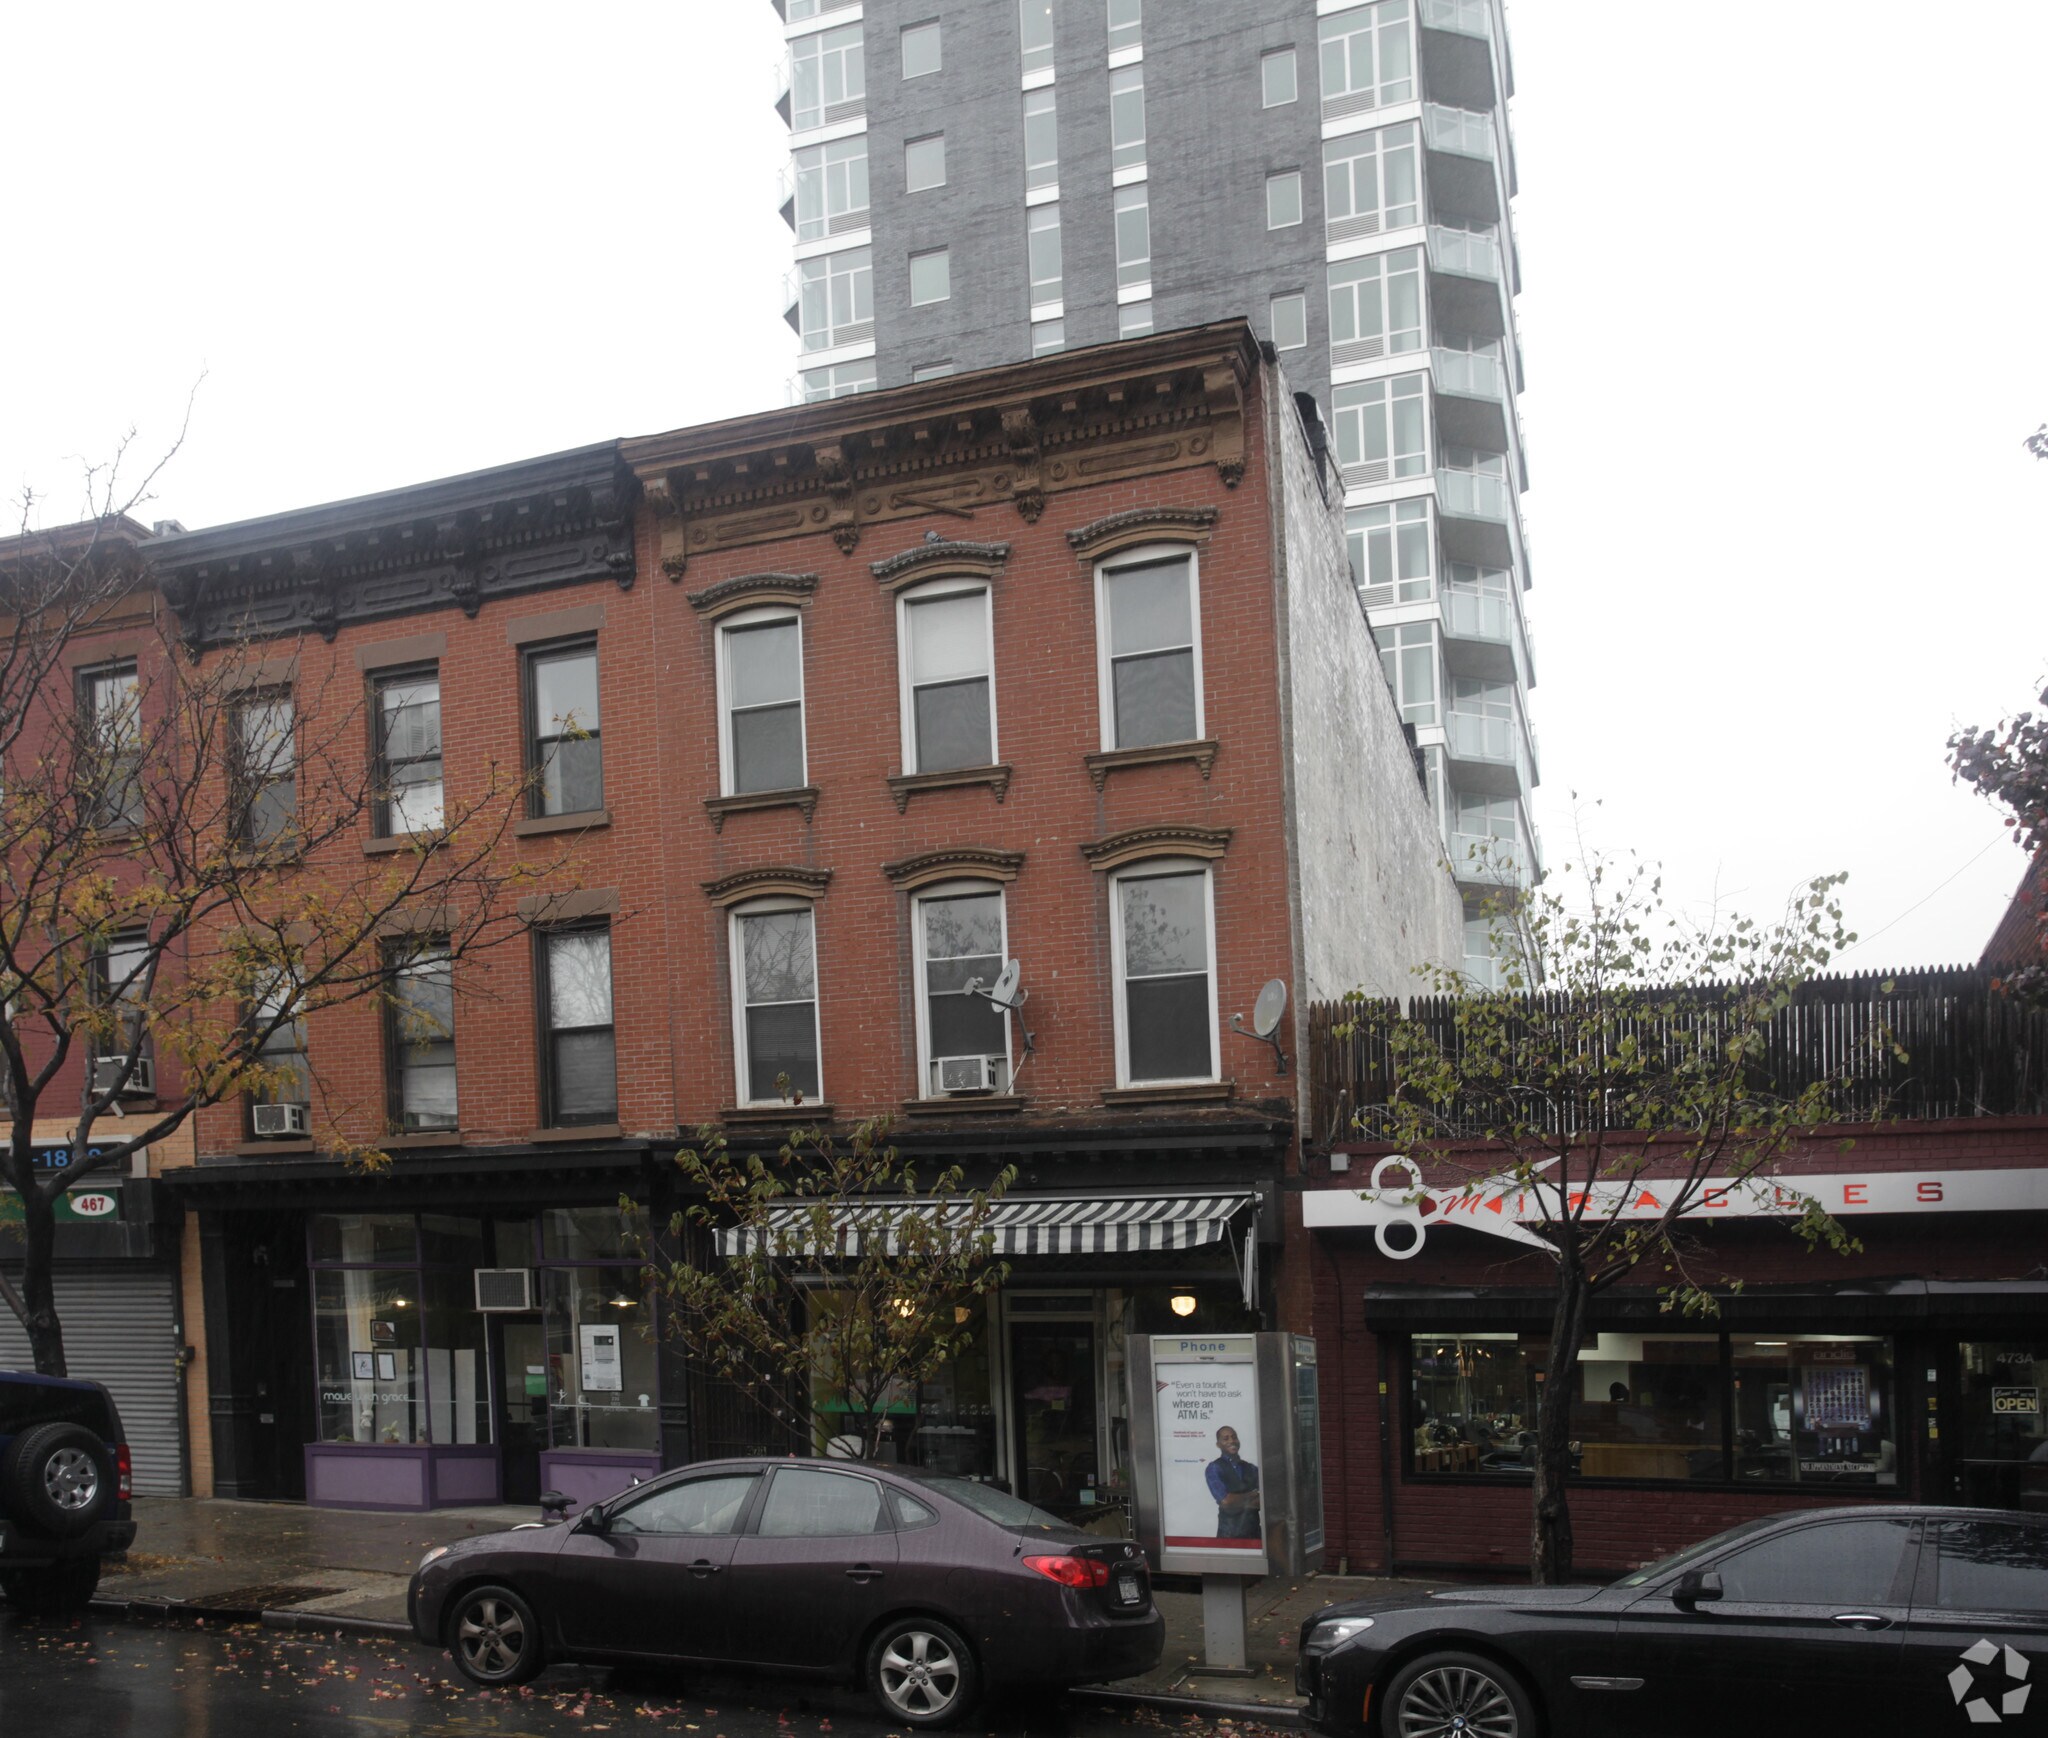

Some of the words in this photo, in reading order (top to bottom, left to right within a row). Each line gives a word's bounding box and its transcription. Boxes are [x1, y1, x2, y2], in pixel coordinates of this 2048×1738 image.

[81, 1197, 105, 1211] 467
[1180, 1341, 1226, 1352] Phone
[1997, 1353, 2034, 1364] 473A
[1202, 1381, 1227, 1389] tourist
[323, 1392, 352, 1401] move
[381, 1393, 409, 1405] grace
[1176, 1390, 1197, 1398] won't
[1198, 1390, 1217, 1398] have
[1218, 1390, 1227, 1398] to
[1227, 1390, 1242, 1398] ask
[1172, 1400, 1200, 1409] where
[1201, 1401, 1213, 1409] an
[1995, 1398, 2036, 1410] OPEN
[1177, 1410, 1198, 1420] ATM
